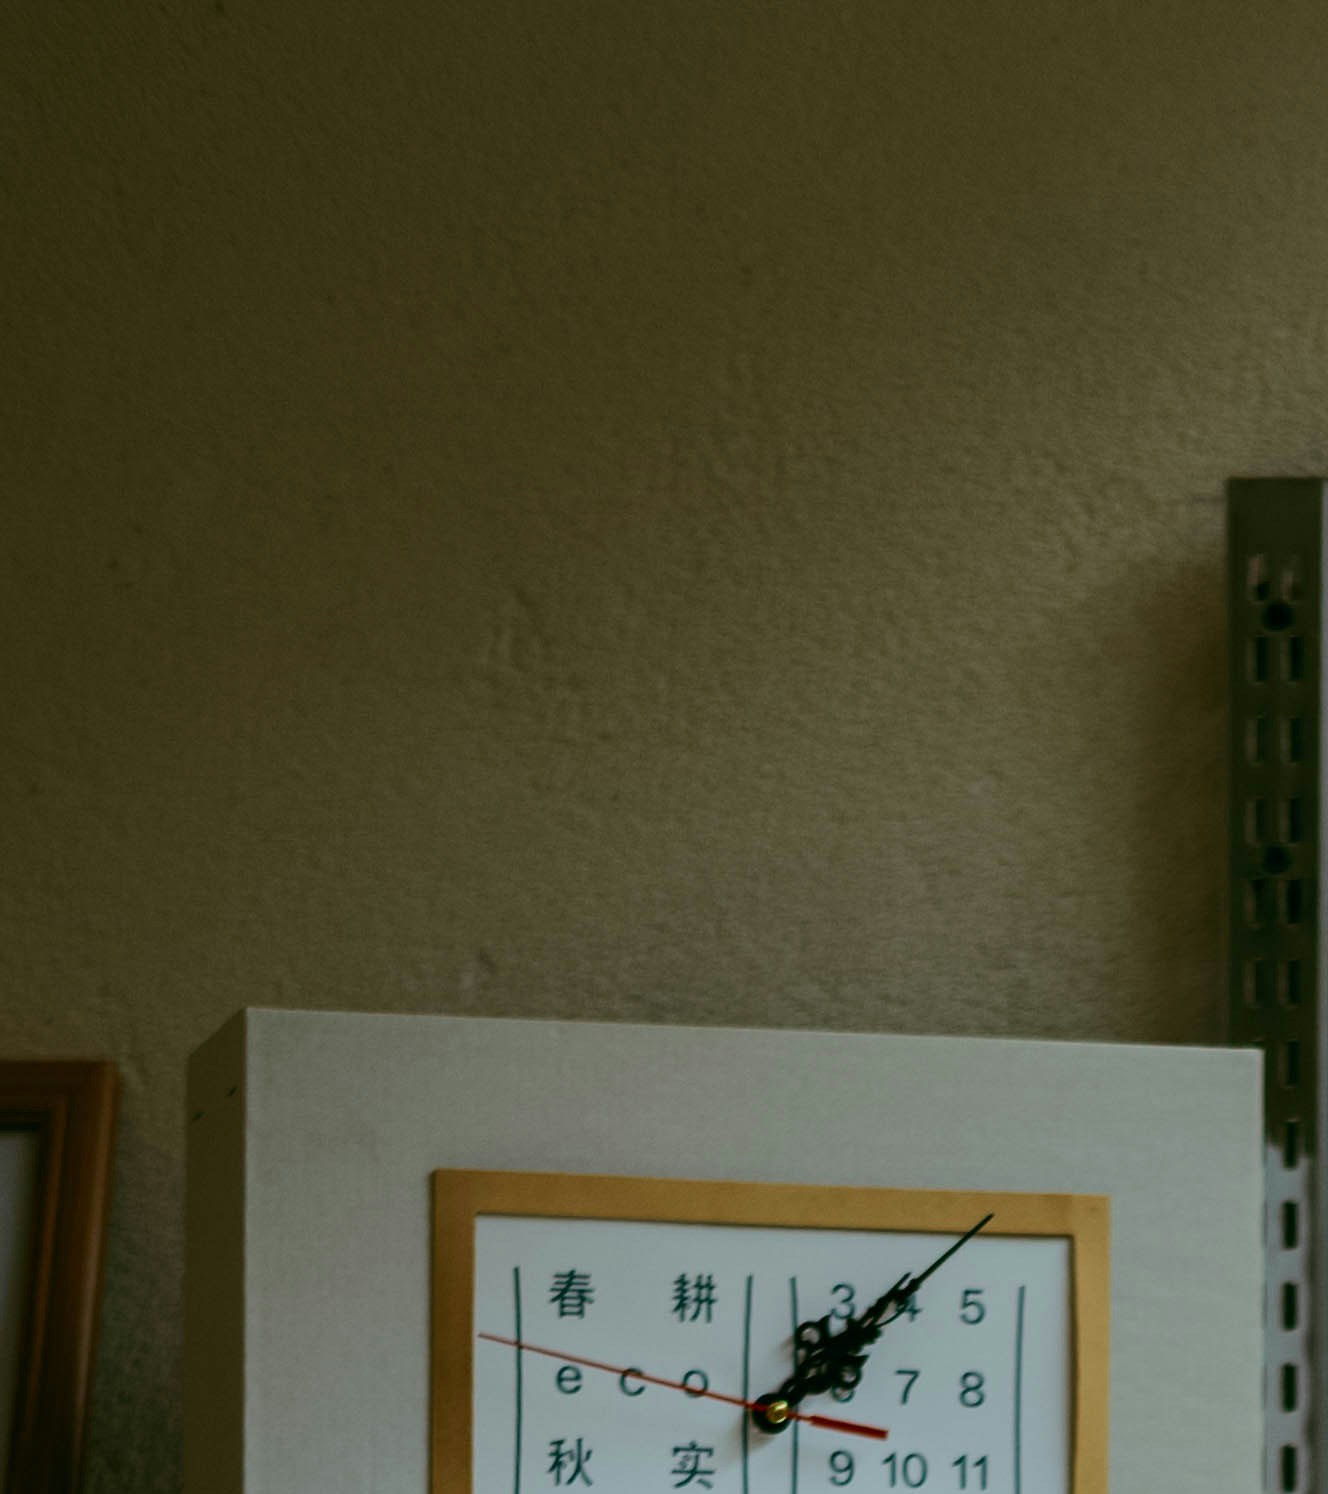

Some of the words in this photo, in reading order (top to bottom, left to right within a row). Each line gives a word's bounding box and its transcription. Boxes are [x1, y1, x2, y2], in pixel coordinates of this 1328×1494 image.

[829, 1283, 856, 1321] 3
[960, 1289, 986, 1325] 5
[894, 1368, 921, 1406] 7
[959, 1371, 985, 1408] 8
[829, 1449, 855, 1487] 9
[883, 1452, 928, 1490] 10
[952, 1454, 988, 1491] 11
